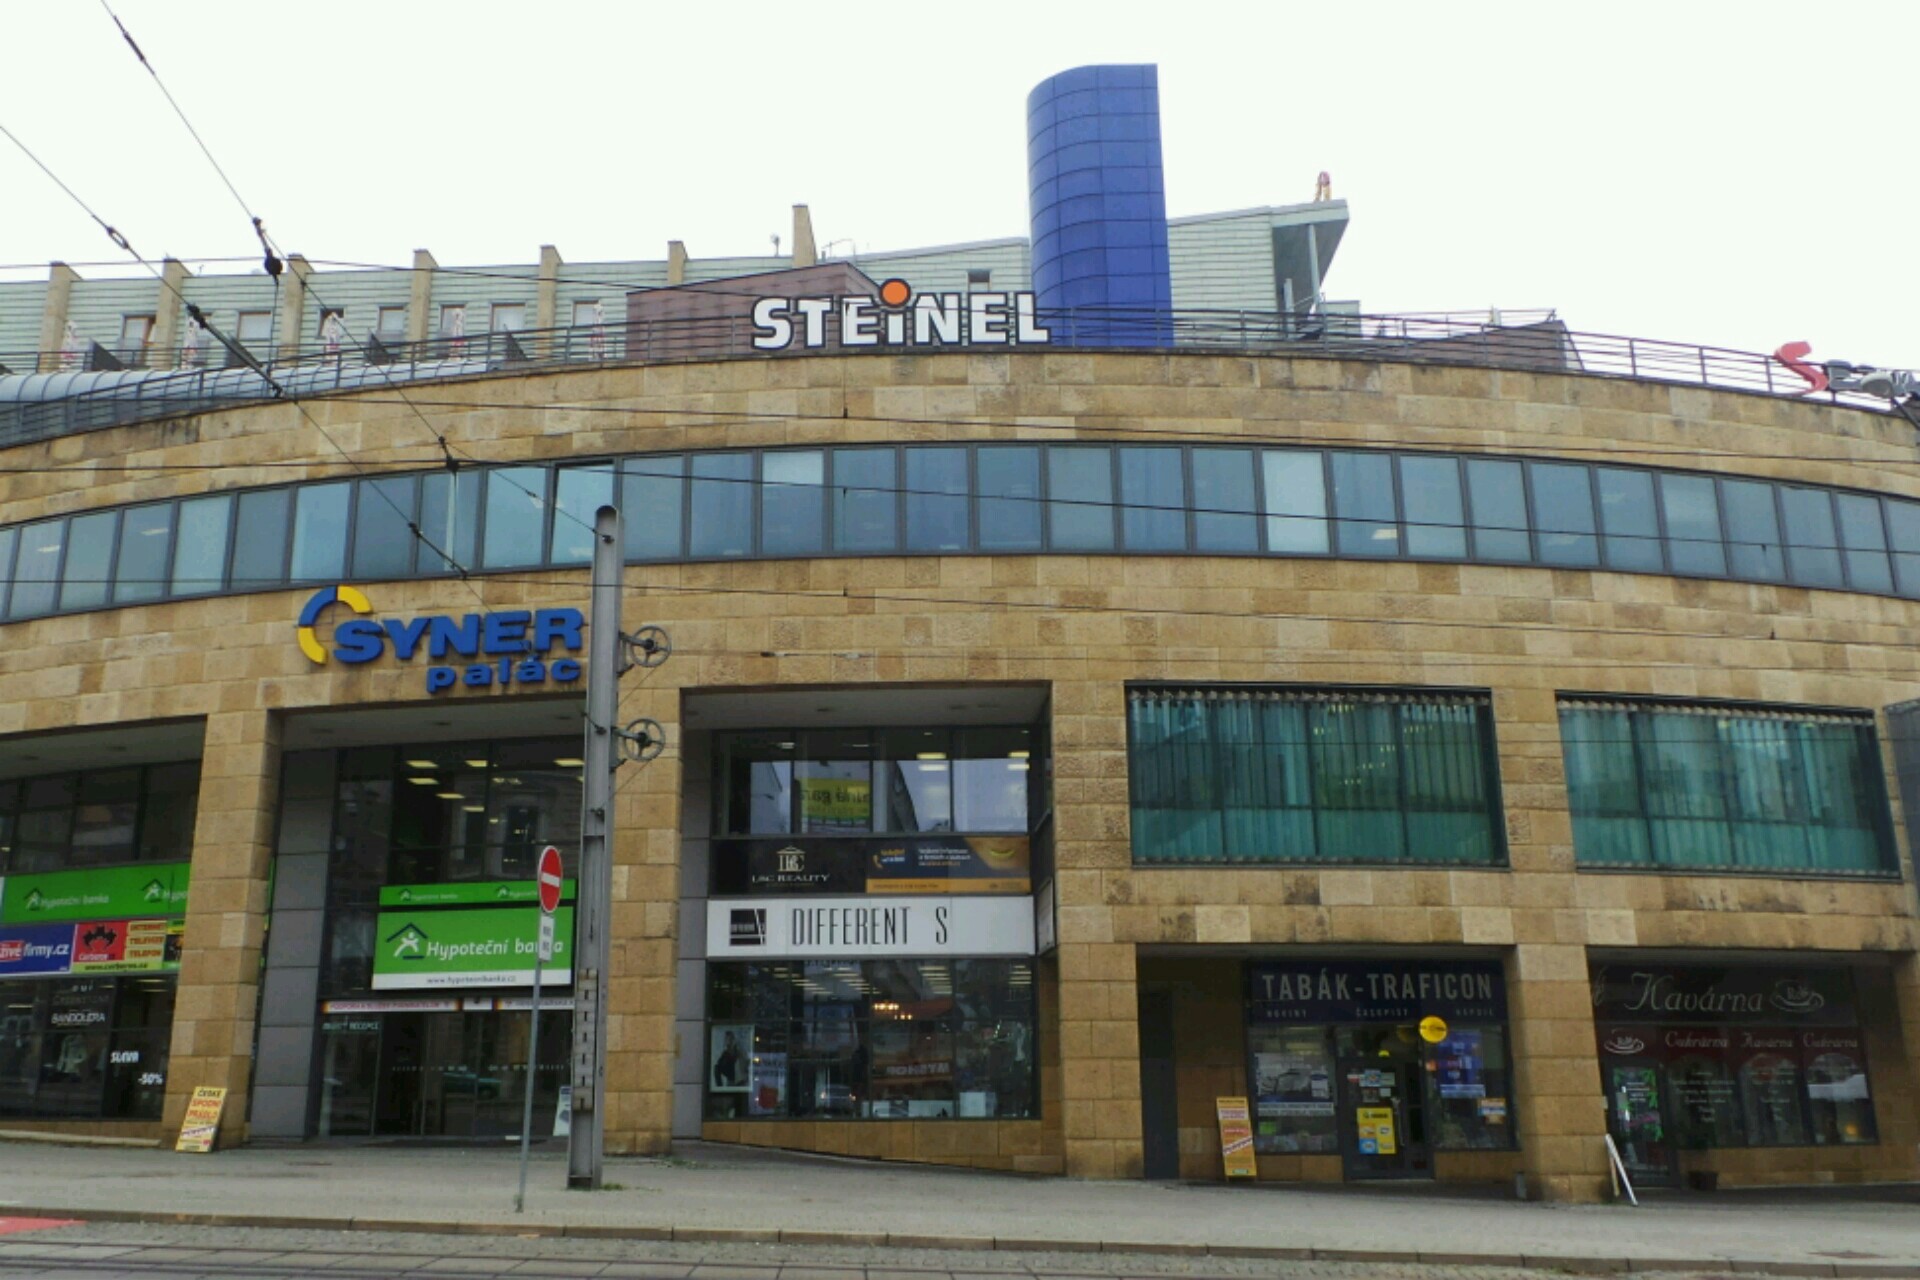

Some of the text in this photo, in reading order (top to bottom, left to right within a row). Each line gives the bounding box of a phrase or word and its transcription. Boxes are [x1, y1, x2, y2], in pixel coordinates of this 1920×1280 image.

[333, 608, 584, 663] SYNER
[427, 653, 582, 693] palác
[792, 905, 949, 946] DIFFERENT S
[426, 938, 509, 961] Hypoteční
[515, 937, 564, 953] bana
[1624, 972, 1763, 1013] Kavárna
